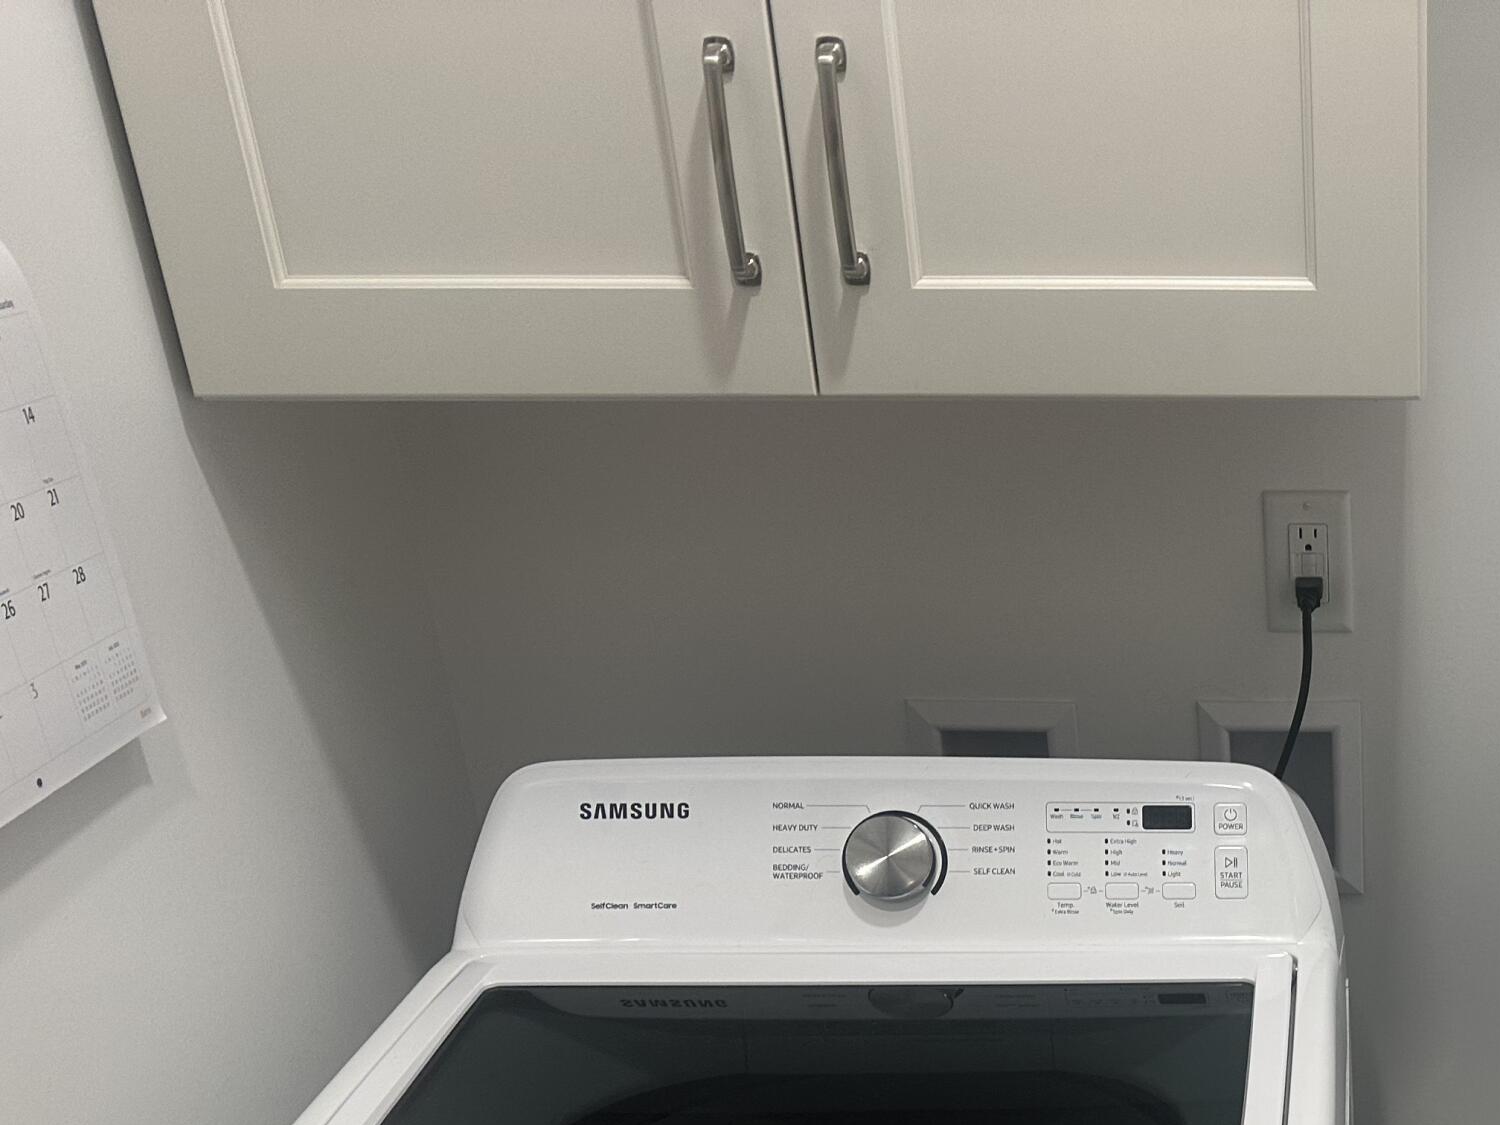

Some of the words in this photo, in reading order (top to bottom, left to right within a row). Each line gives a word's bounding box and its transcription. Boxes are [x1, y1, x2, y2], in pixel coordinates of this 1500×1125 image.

[22, 406, 36, 425] 14
[47, 488, 60, 506] 21
[10, 502, 25, 521] 20
[72, 566, 86, 585] 28
[37, 583, 51, 602] 27
[1, 600, 16, 620] 26
[772, 802, 805, 810] NORMAL
[969, 802, 992, 810] QUICK
[993, 802, 1015, 810] WASH
[580, 802, 691, 820] SAMSUNG
[772, 824, 797, 832] HEAVY
[799, 824, 818, 832] DUTY
[973, 824, 992, 832] DEEP
[993, 824, 1015, 832] WASH
[772, 846, 812, 854] DELICATES
[772, 863, 809, 871] BEDDING/
[772, 872, 823, 880] WATERPROOF
[973, 868, 991, 876] SELF
[1220, 881, 1243, 889] PAUSE
[591, 902, 629, 910] SelfClean
[633, 902, 678, 910] SmartCare
